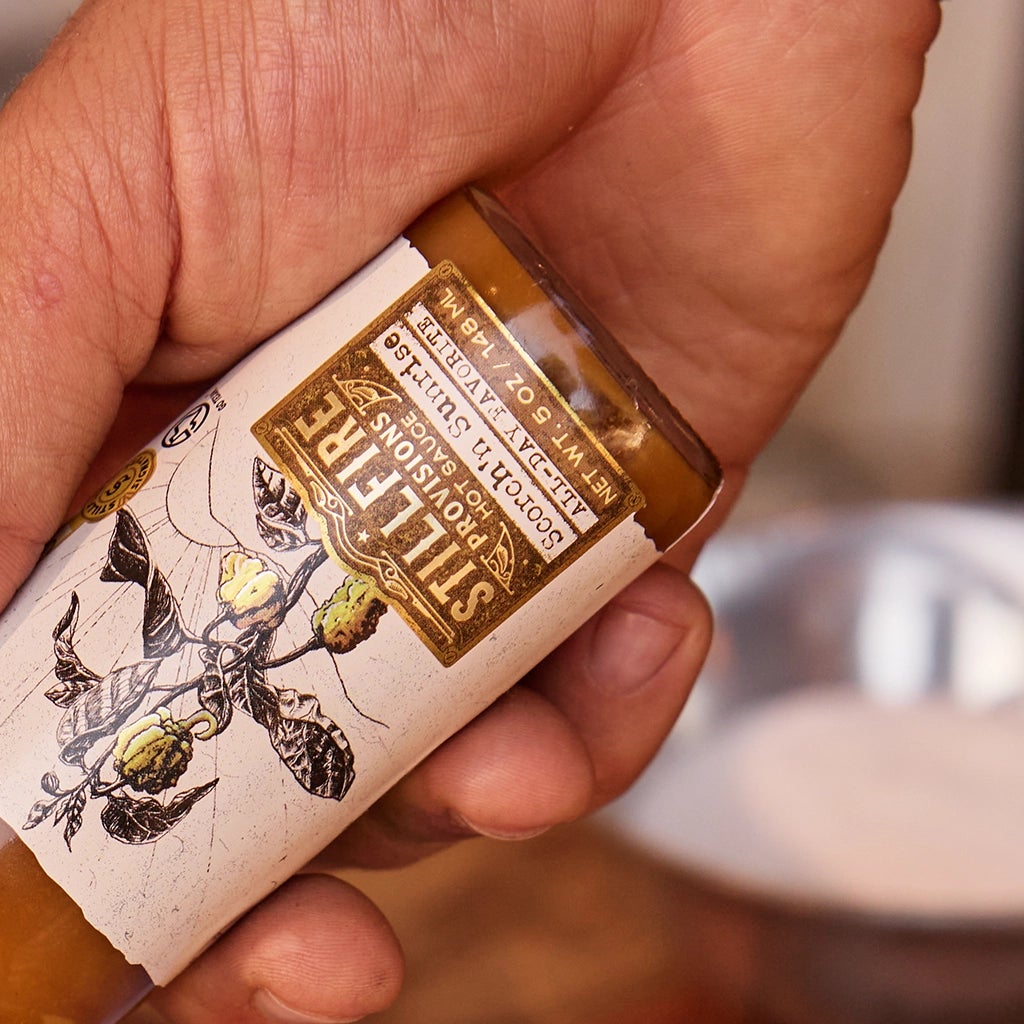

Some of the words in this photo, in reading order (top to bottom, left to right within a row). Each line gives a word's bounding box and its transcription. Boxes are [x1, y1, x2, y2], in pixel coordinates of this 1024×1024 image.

[439, 287, 465, 319] ML
[460, 317, 496, 359] 148
[383, 331, 472, 439] Sunrise
[417, 315, 506, 421] FAVORITE
[505, 373, 534, 405] OZ
[400, 410, 457, 476] SAUCE
[531, 406, 552, 425] 5
[504, 423, 587, 517] ALL-DAY
[551, 423, 584, 468] WT.
[294, 391, 495, 622] STILLFIRE
[370, 411, 489, 551] PROVISIONS
[453, 479, 494, 521] HOT
[472, 436, 564, 551] Scorch'n
[581, 468, 618, 505] NET
